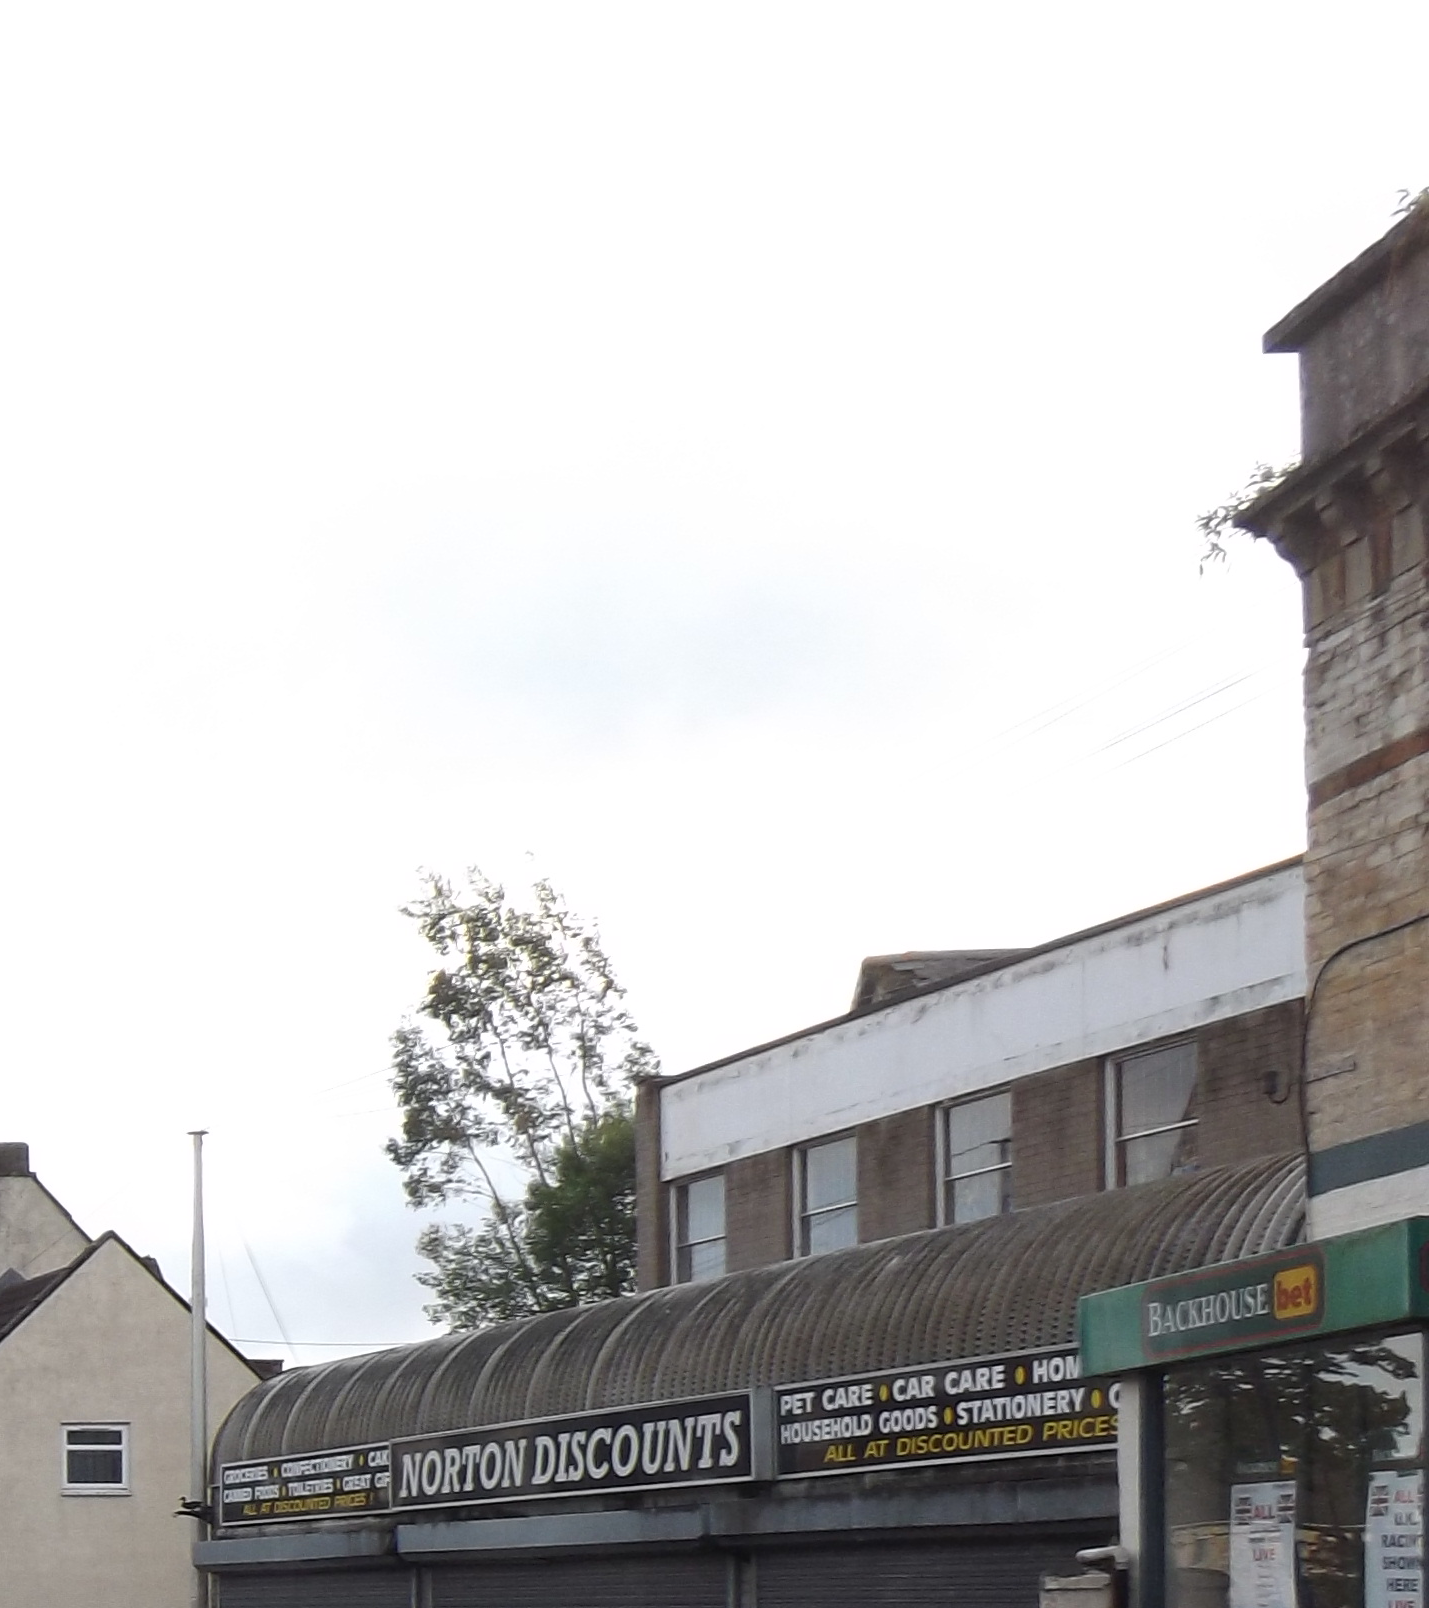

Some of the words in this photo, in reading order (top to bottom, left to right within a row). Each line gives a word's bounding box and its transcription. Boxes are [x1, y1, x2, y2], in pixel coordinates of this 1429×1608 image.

[1147, 1283, 1270, 1337] BACKHOUSE
[1276, 1277, 1312, 1311] bet
[780, 1393, 815, 1416] PET
[822, 1384, 873, 1411] CARE
[892, 1376, 935, 1401] CAR
[944, 1365, 1006, 1395] CARE
[780, 1414, 873, 1445] HOUSEHOLD
[879, 1405, 938, 1434] GOODS
[956, 1387, 1086, 1426] STATIONERY
[823, 1444, 857, 1464] ALL
[863, 1440, 889, 1459] AT
[896, 1424, 1034, 1457] DISCOUNTED
[1042, 1415, 1119, 1442] PRICES
[281, 1454, 355, 1478] CONFECTIONERY
[398, 1438, 528, 1499] NORTON
[531, 1409, 742, 1486] DISCOUNTS
[243, 1503, 258, 1516] ALL
[260, 1502, 272, 1513] AT
[273, 1496, 331, 1514] DISCOUNTED
[333, 1492, 367, 1508] PRICES
[287, 1478, 334, 1497] TOILETRIES
[342, 1473, 372, 1491] GREAT
[1386, 1577, 1419, 1592] HERE
